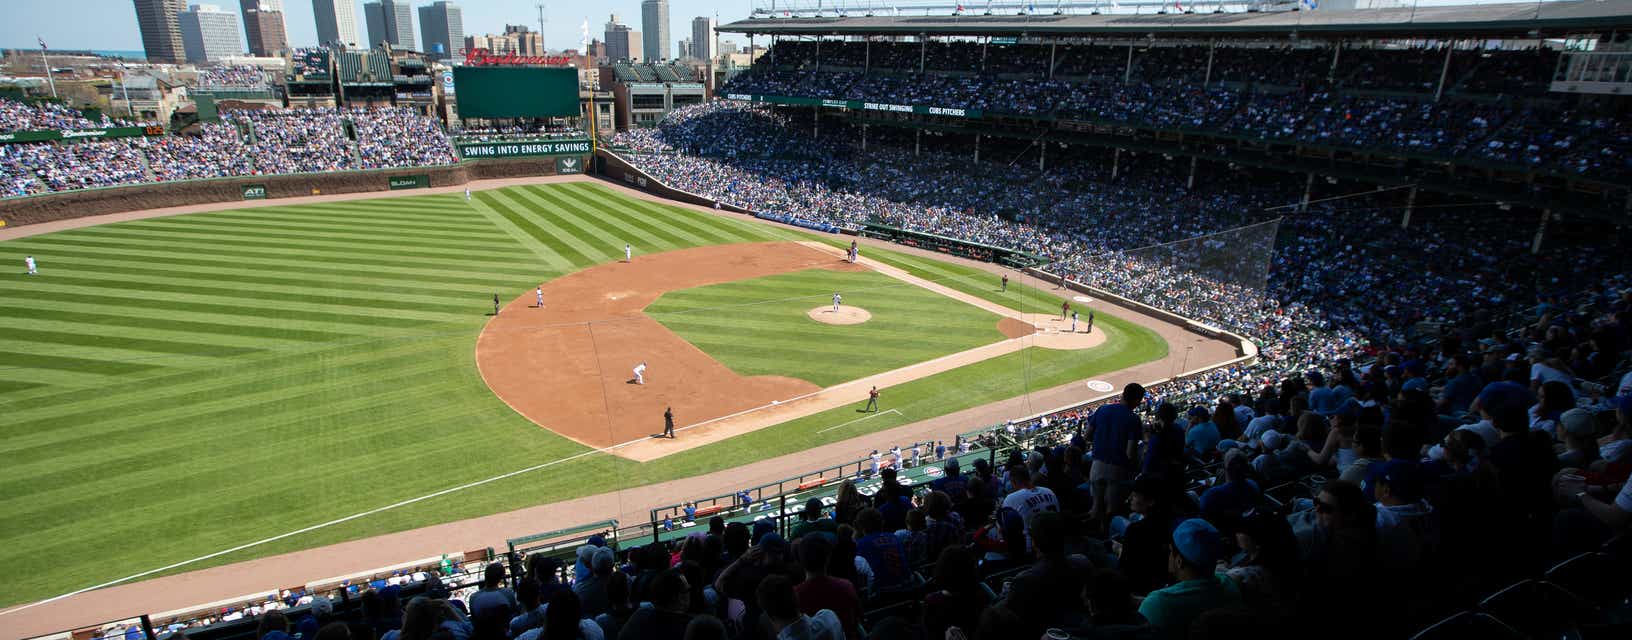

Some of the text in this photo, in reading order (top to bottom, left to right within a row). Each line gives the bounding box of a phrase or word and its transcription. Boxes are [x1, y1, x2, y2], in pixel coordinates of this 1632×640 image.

[459, 48, 570, 66] Budweiser
[943, 108, 965, 116] PITCHERS
[465, 143, 589, 155] SWING INTO ENERGY SAVINGS
